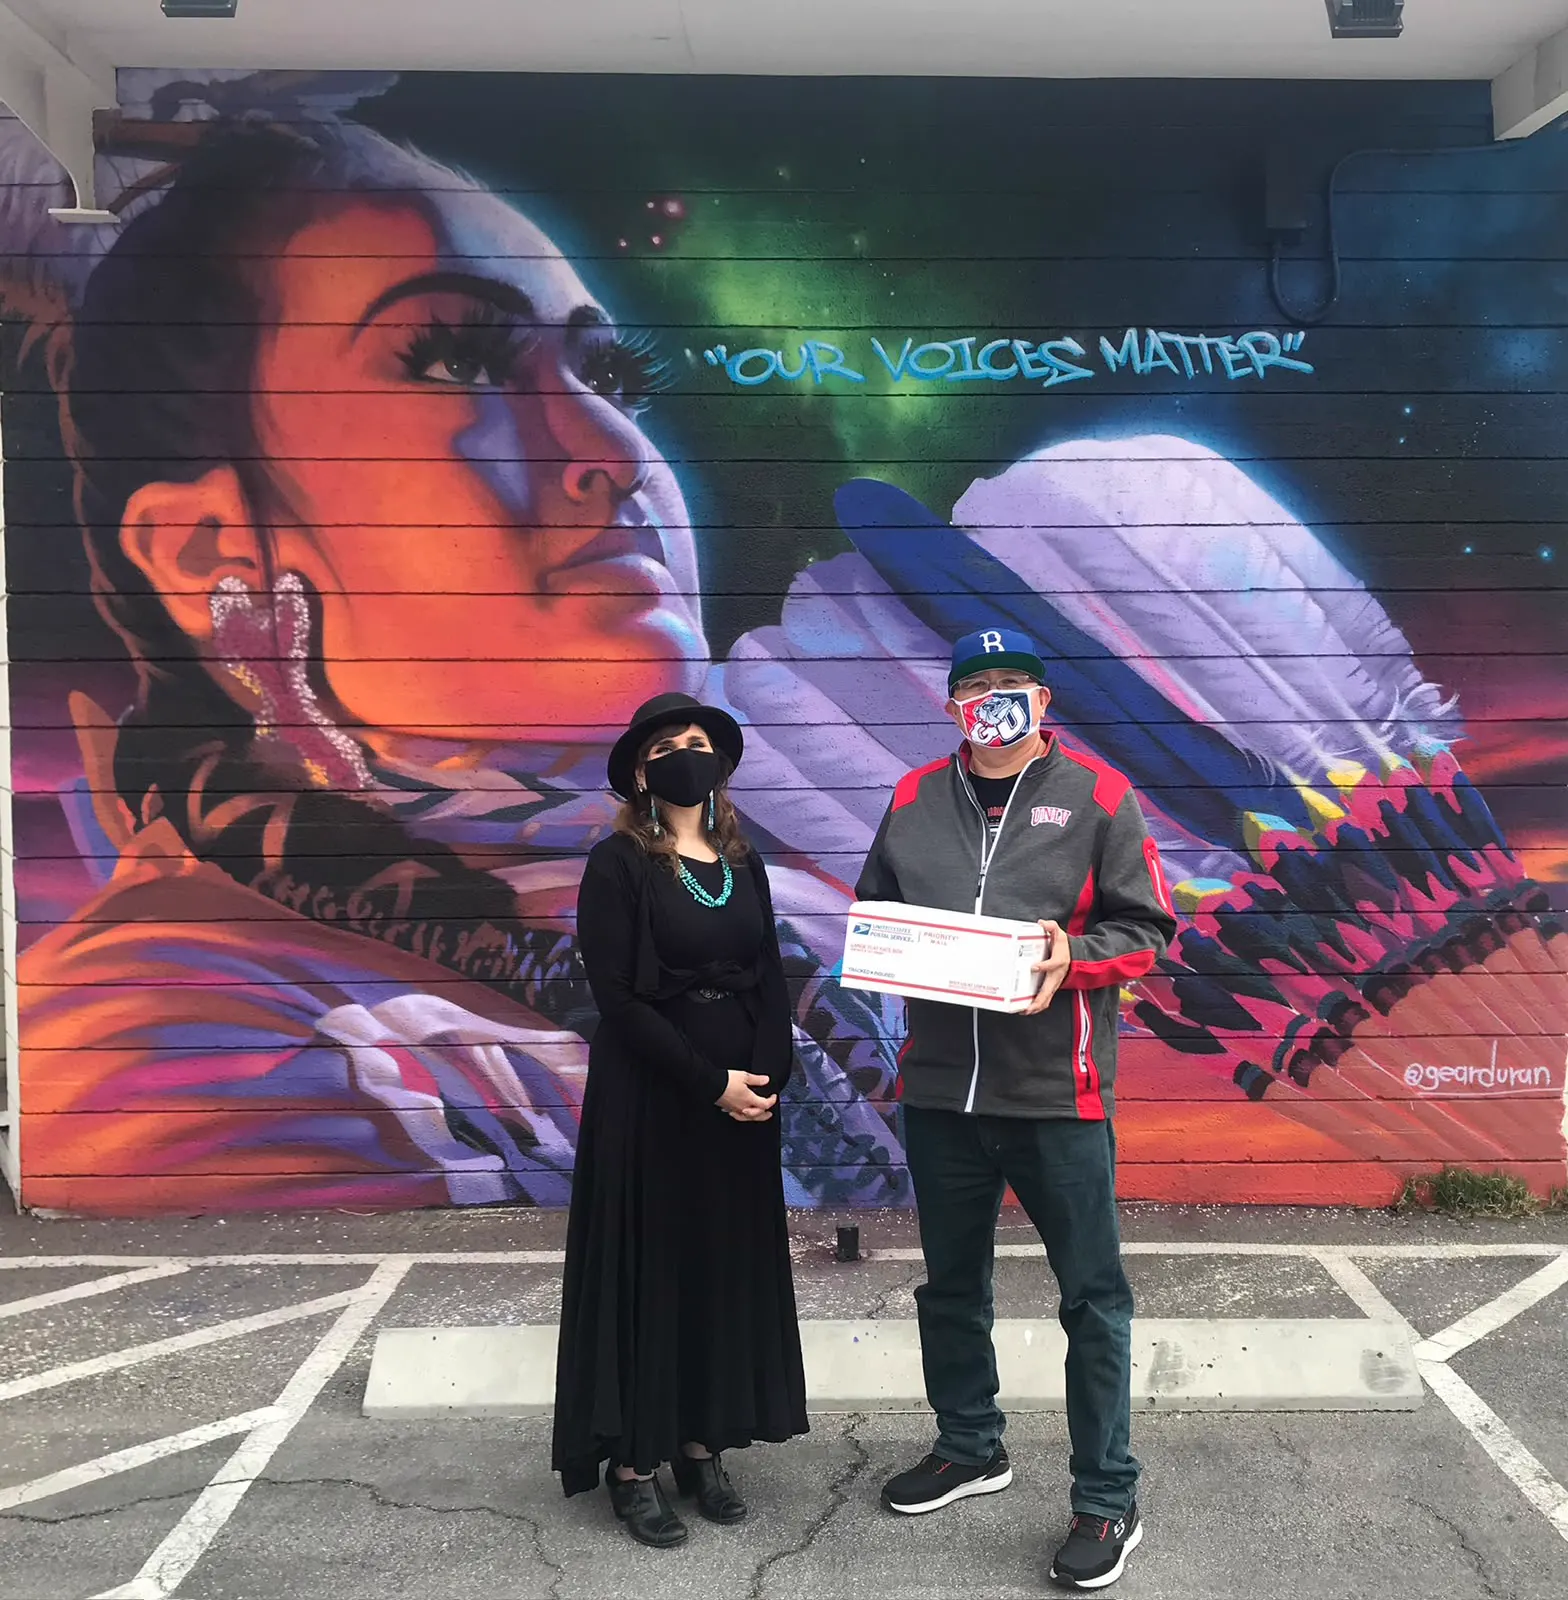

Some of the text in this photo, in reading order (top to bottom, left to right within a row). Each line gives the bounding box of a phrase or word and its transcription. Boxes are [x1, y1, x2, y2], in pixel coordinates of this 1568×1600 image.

[705, 328, 1315, 388] "OUR VOICES MATTER"
[1031, 806, 1072, 828] UNLV
[1404, 1039, 1551, 1090] @gearduran
